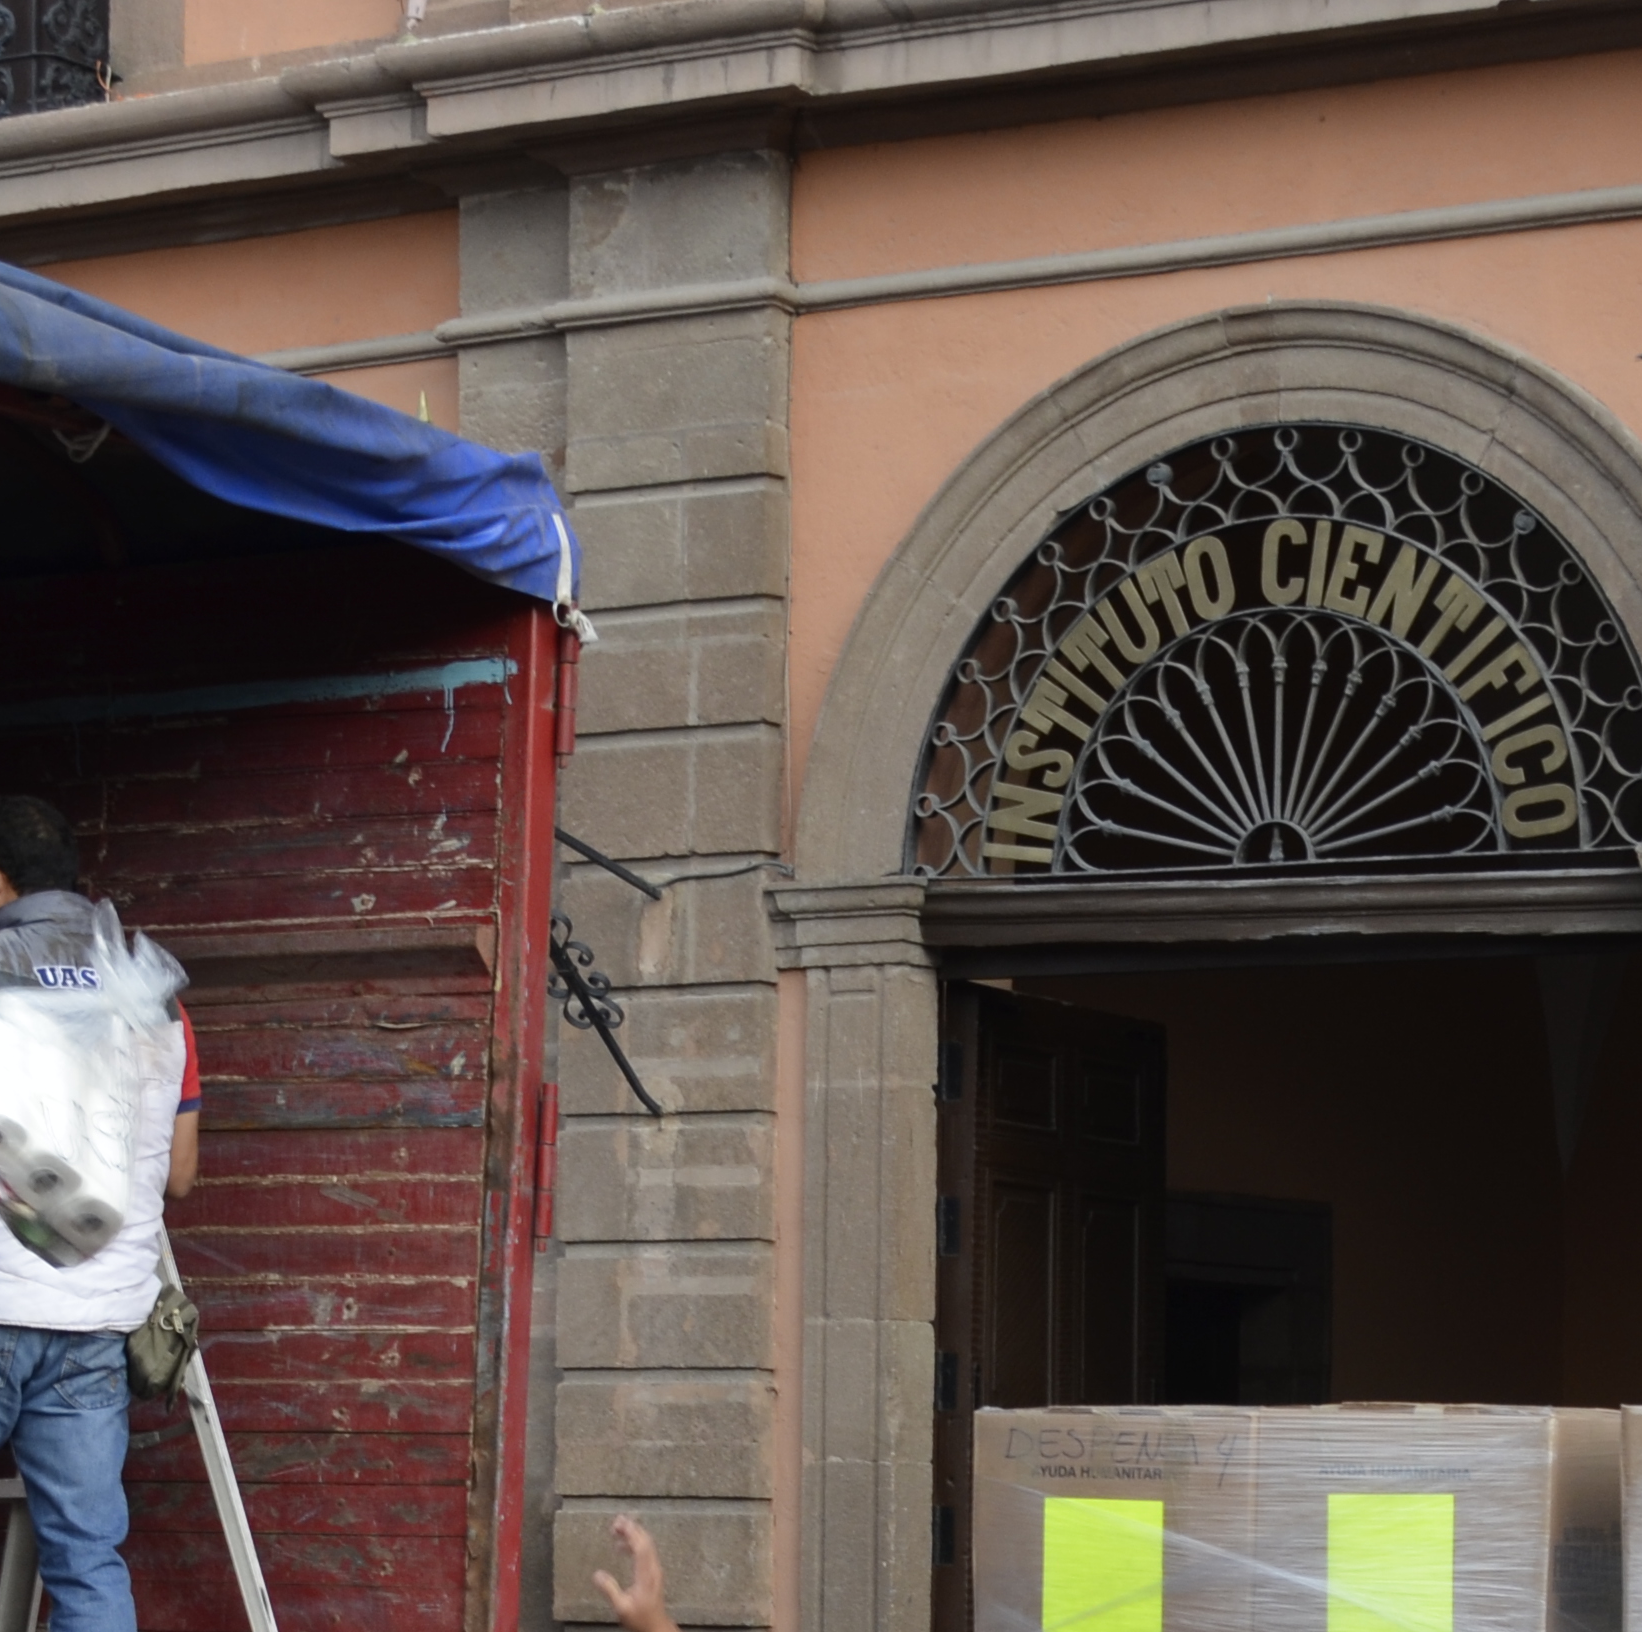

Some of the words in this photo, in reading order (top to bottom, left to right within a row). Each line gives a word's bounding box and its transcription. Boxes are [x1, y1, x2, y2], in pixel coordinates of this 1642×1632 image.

[982, 534, 1237, 864] INSTITUTO
[1261, 518, 1578, 839] CIENTIFICO
[33, 965, 102, 991] UAS
